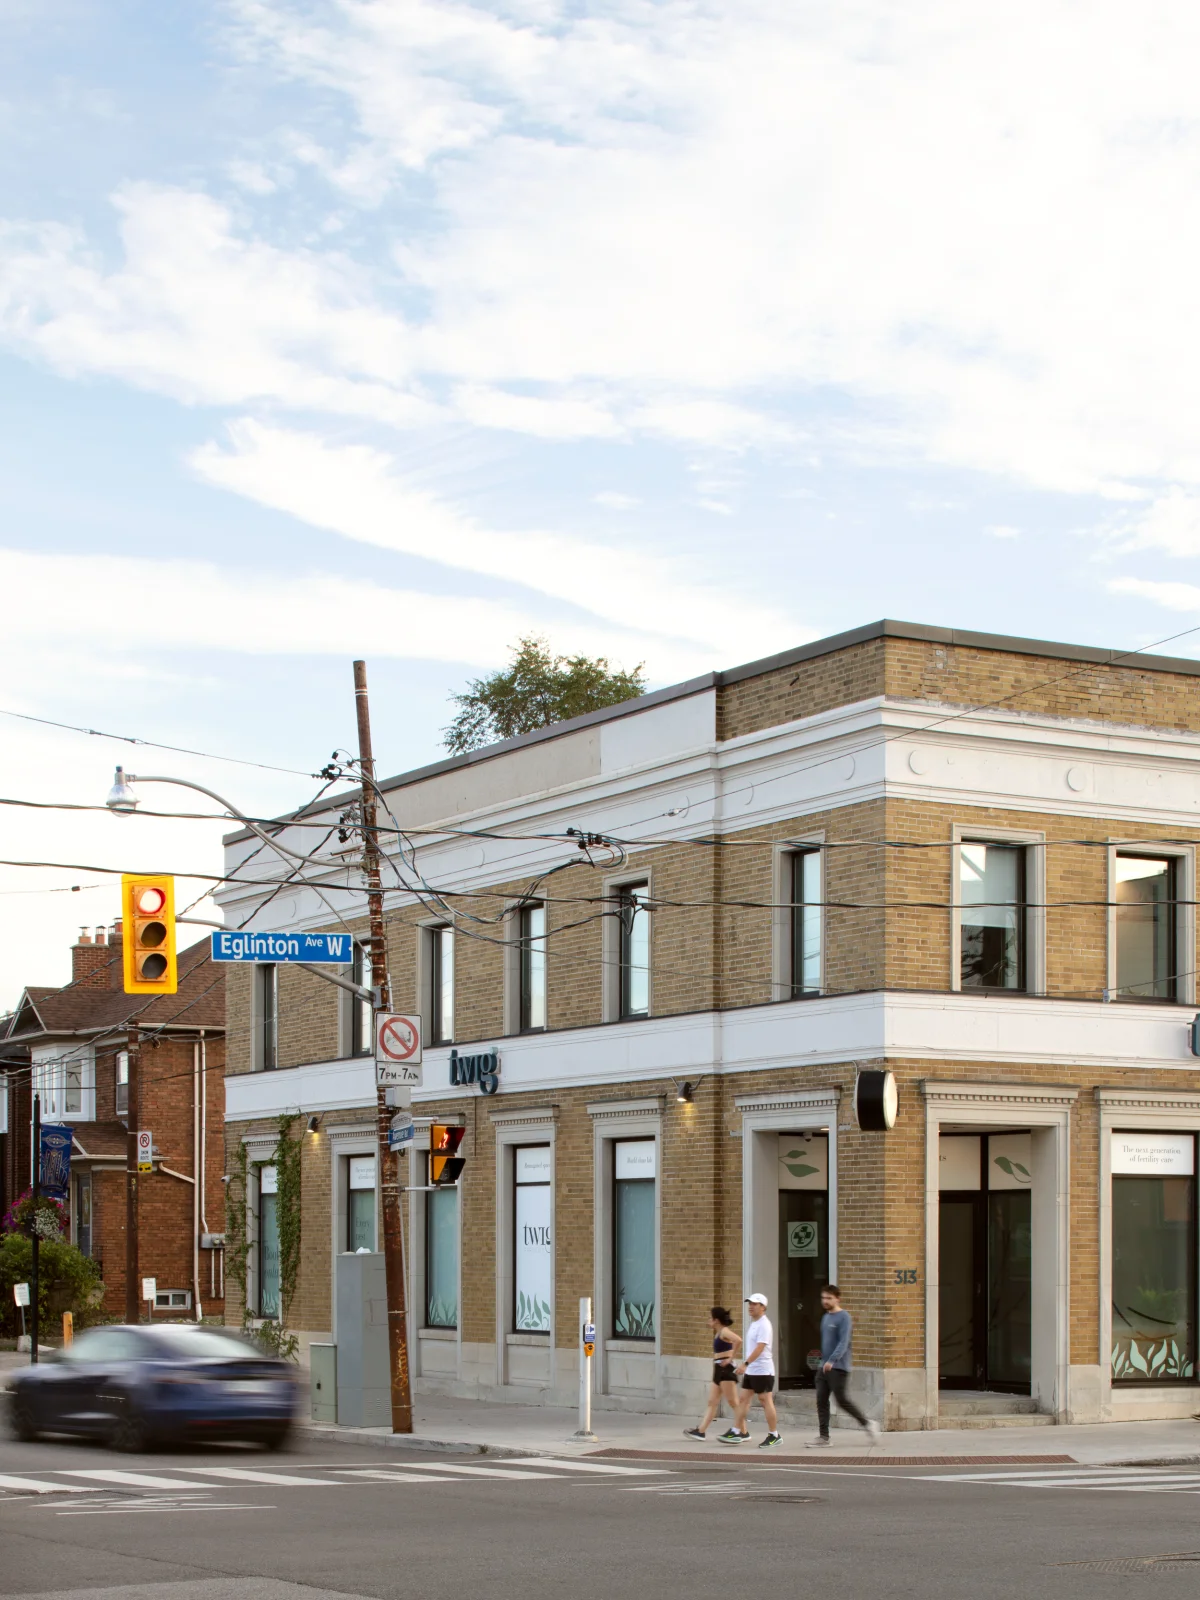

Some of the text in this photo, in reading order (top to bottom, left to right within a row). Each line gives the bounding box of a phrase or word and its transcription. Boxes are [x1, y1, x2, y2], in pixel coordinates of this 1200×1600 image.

[221, 934, 343, 959] Eglinton Ave W
[448, 1047, 499, 1095] twig
[894, 1269, 918, 1285] 313
